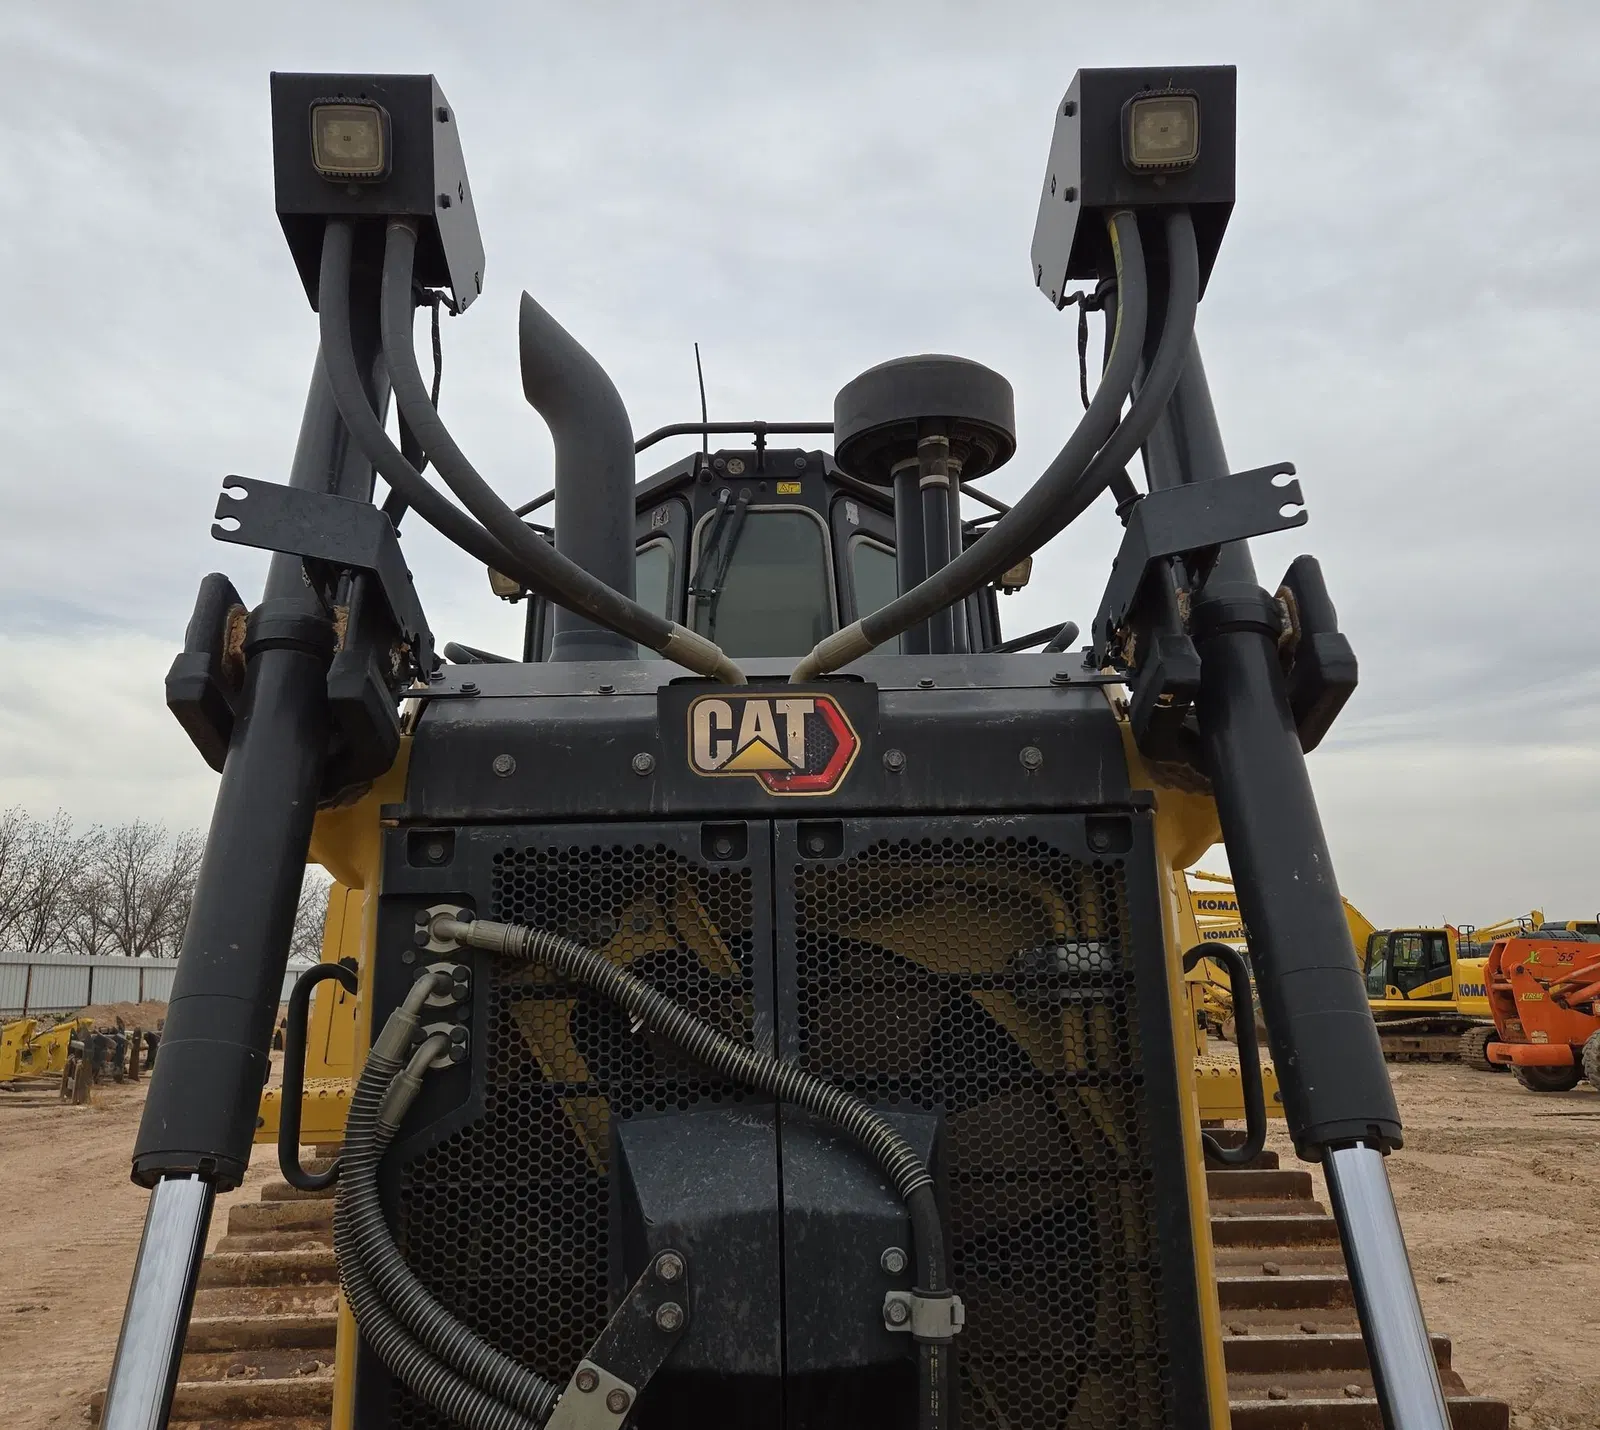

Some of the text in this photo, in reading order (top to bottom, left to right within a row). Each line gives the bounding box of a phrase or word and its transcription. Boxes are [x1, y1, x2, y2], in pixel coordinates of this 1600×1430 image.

[693, 699, 815, 770] CAT
[1197, 900, 1238, 910] KOMA
[1203, 931, 1245, 940] KOMATS
[1458, 984, 1487, 996] KOMA
